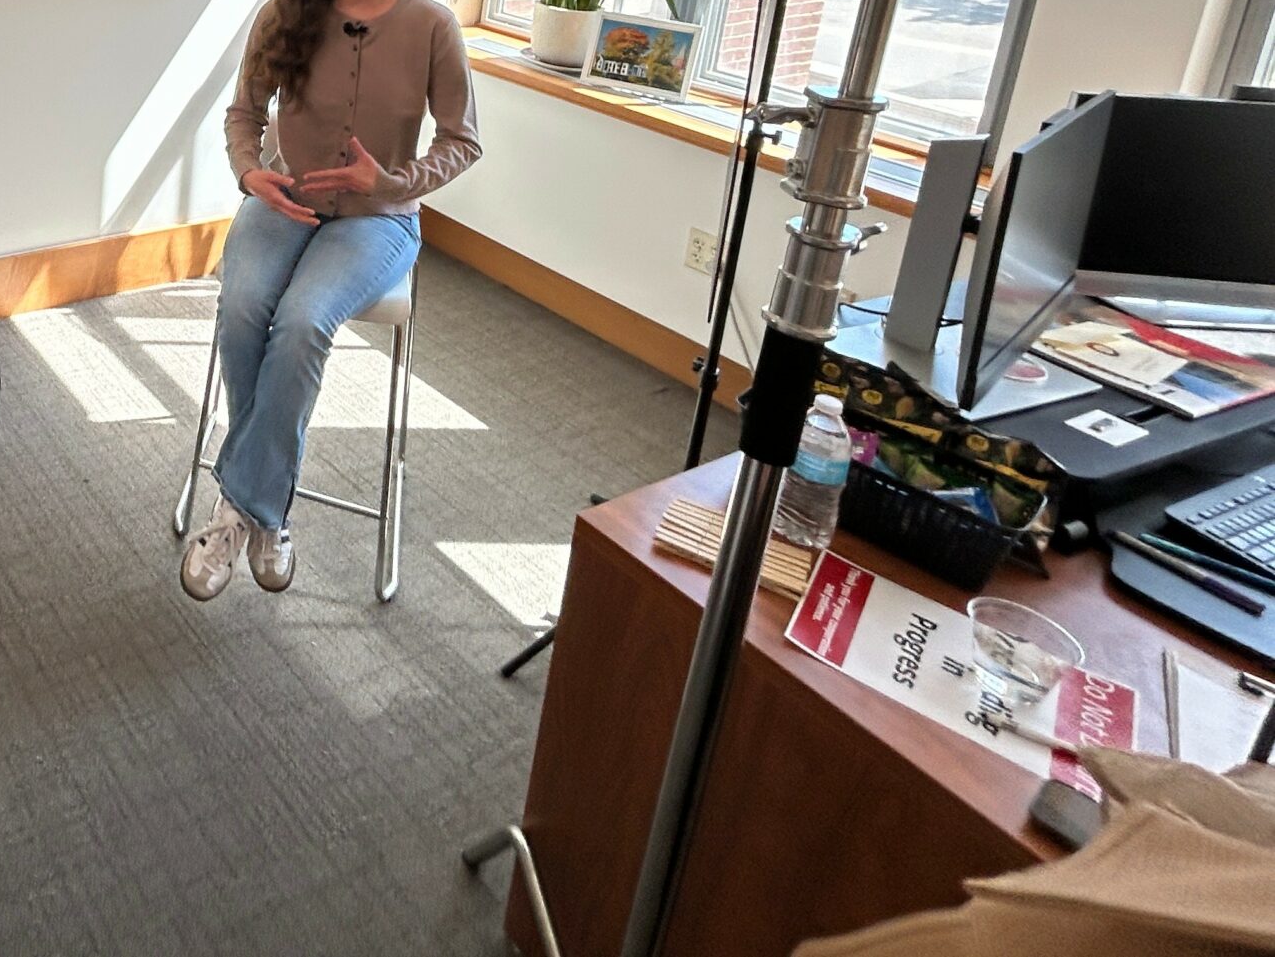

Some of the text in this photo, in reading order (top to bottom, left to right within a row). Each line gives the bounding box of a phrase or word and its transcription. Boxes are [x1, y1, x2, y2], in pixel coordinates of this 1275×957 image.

[891, 612, 937, 690] Progress
[940, 654, 973, 677] in
[1083, 672, 1116, 701] Do
[1079, 697, 1115, 737] Not
